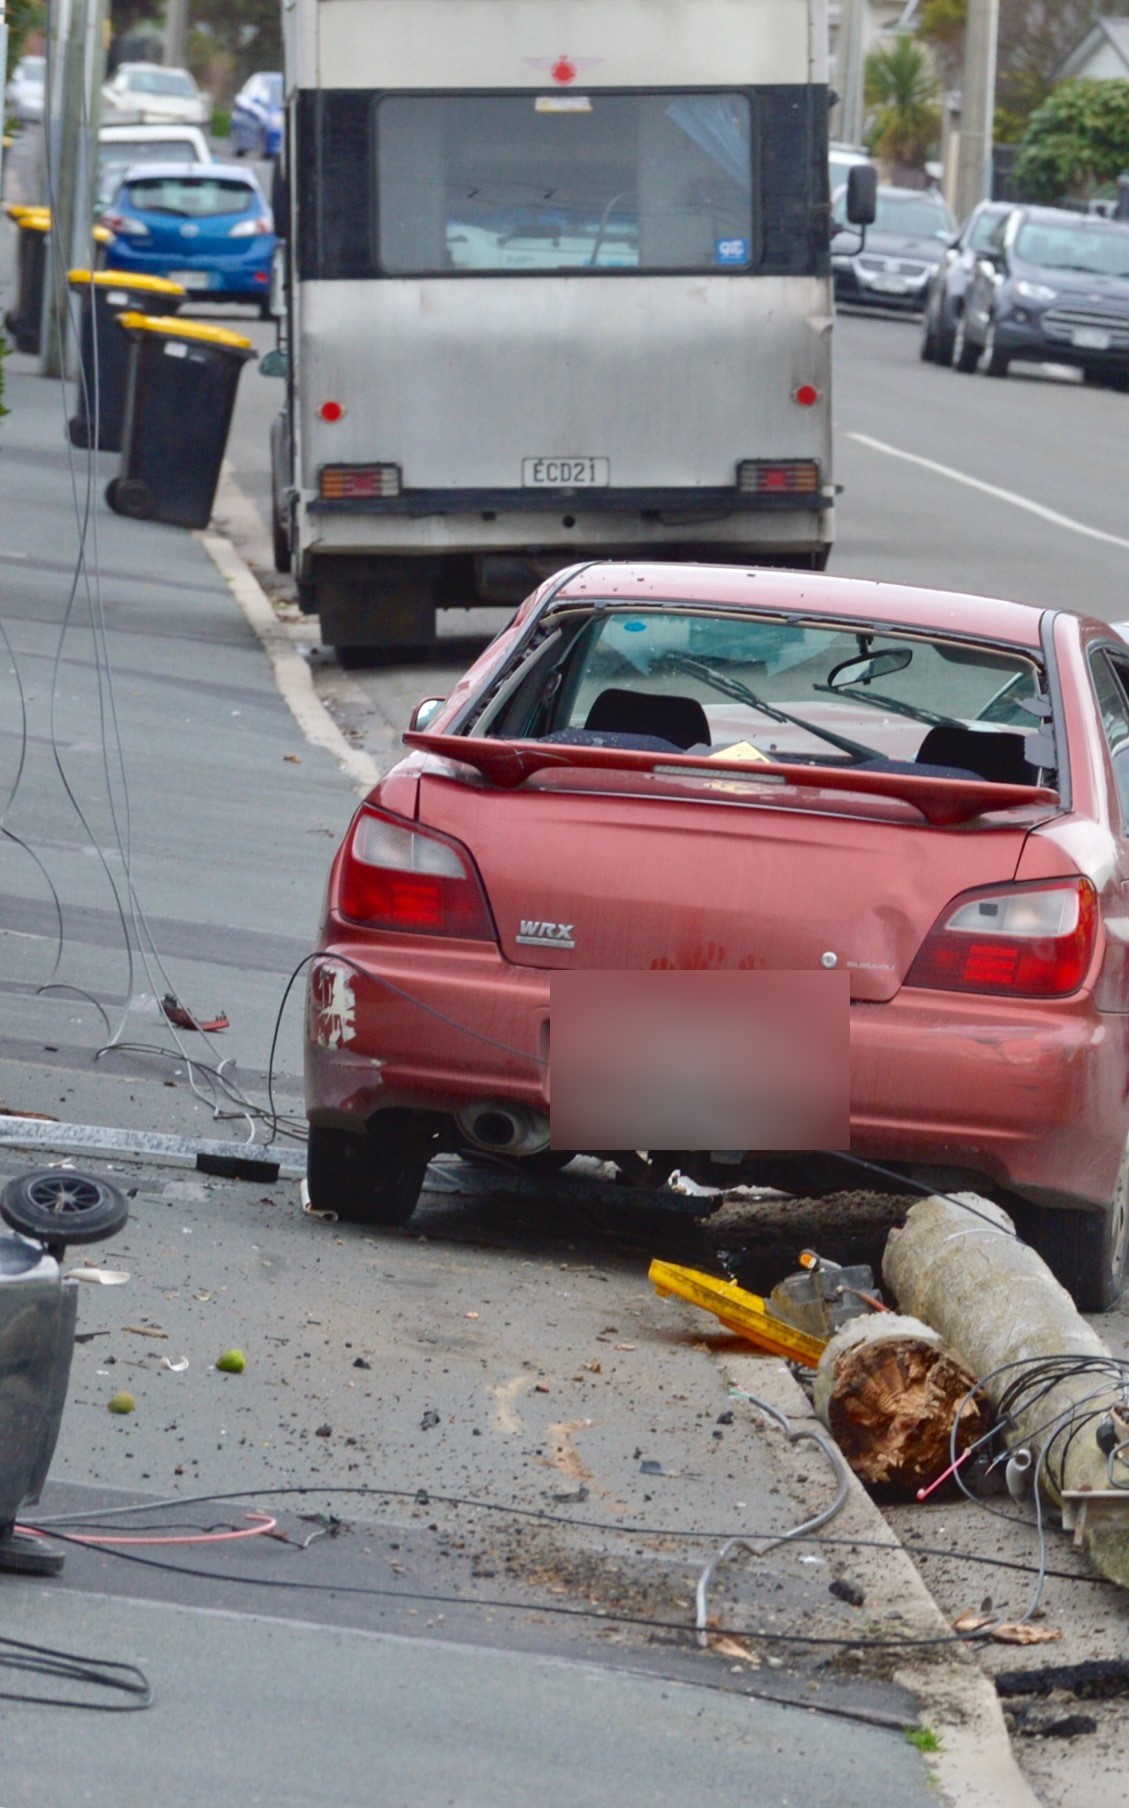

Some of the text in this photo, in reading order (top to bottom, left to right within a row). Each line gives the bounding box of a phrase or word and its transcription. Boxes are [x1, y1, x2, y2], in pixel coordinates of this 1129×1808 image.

[533, 462, 595, 482] ECD21
[520, 920, 574, 940] WRX
[846, 960, 895, 971] SUBARU
